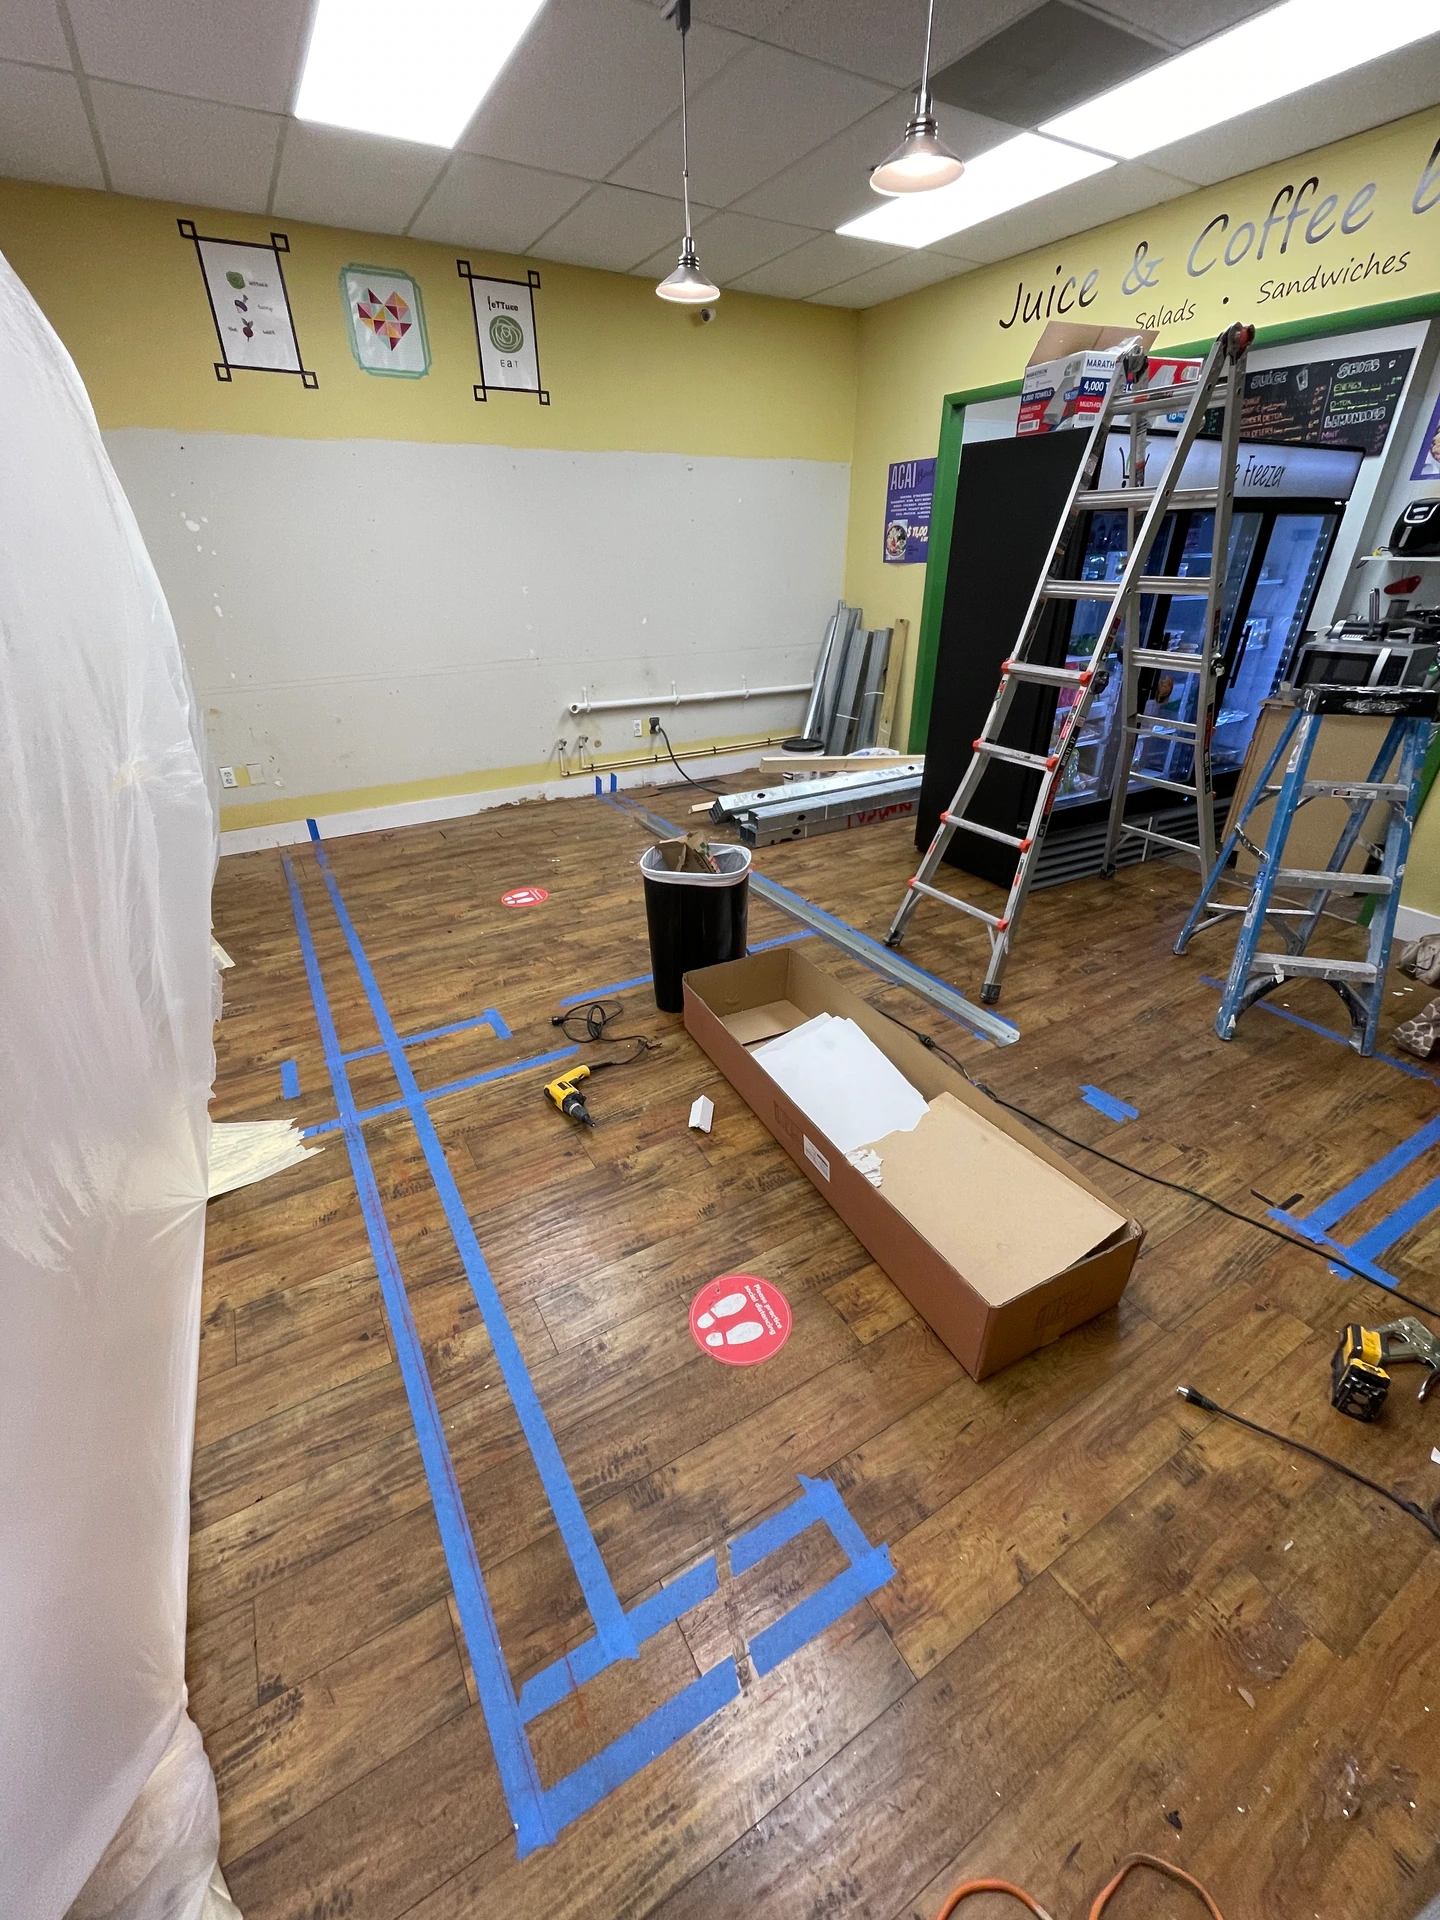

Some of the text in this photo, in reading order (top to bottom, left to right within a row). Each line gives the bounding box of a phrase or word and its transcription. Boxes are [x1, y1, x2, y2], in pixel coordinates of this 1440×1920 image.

[1000, 264, 1099, 330] Juice
[1121, 240, 1165, 296] &
[1186, 176, 1377, 277] Coffee
[1135, 250, 1411, 331] Salads Sandwiches
[1083, 380, 1104, 392] 4,000
[890, 462, 917, 491] ACAI
[1242, 455, 1286, 488] Freezer
[744, 1285, 777, 1336] social distancing
[753, 1283, 783, 1329] Please practice
